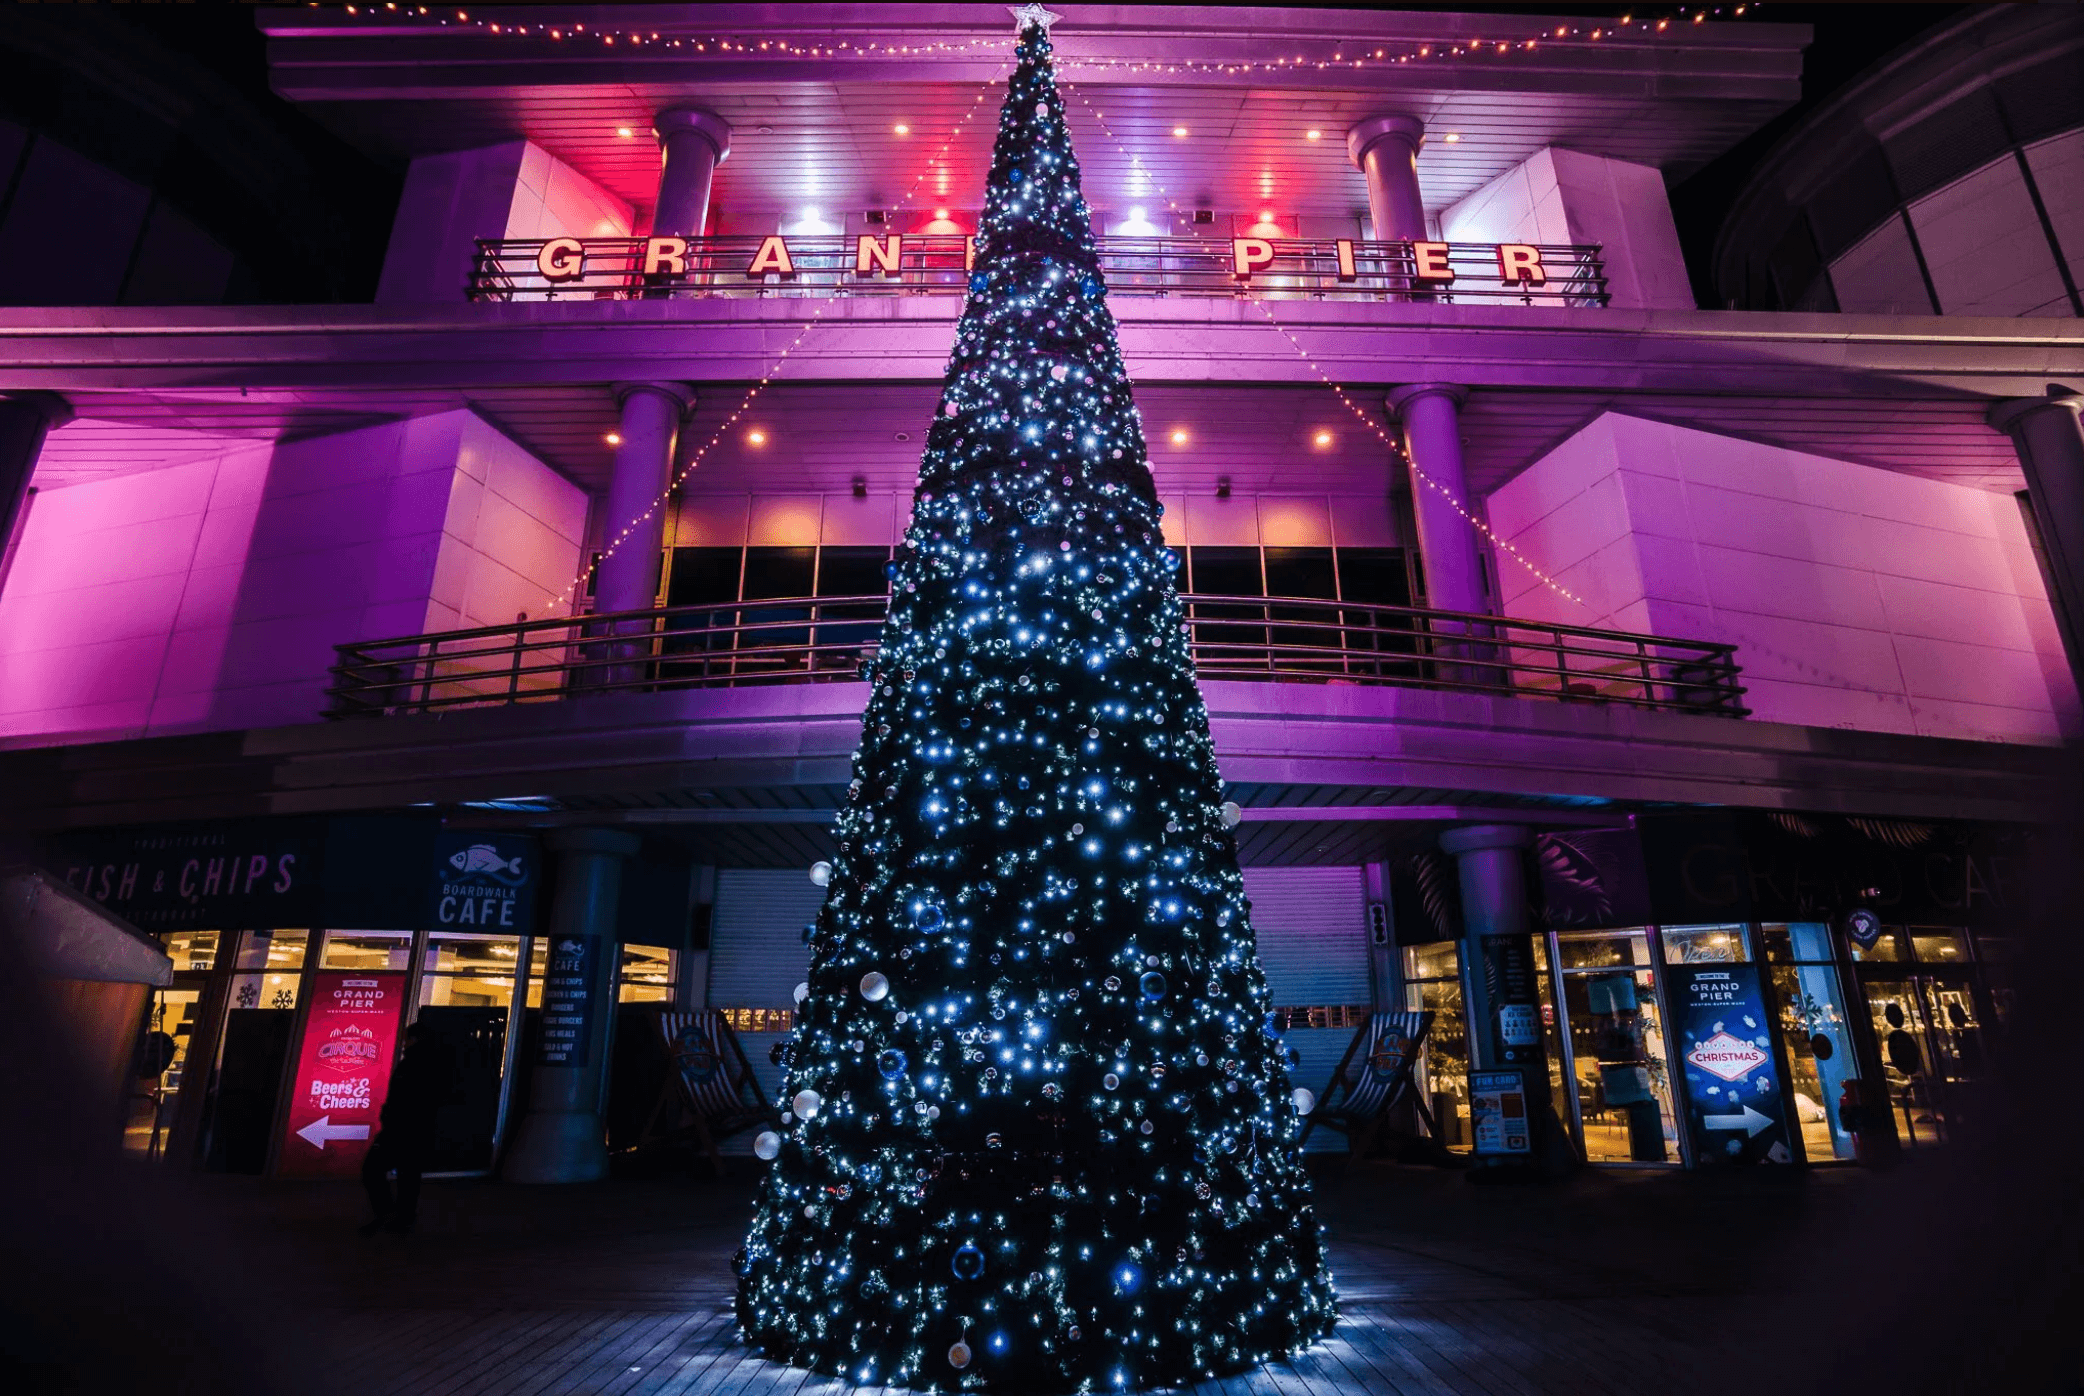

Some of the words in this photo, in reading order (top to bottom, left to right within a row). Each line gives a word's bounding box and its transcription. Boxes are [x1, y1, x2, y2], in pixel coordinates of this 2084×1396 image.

[537, 235, 973, 283] GRAN
[1231, 236, 1547, 288] PIER
[66, 862, 141, 901] FISH
[152, 869, 166, 893] &
[178, 853, 297, 898] CHIPS
[442, 883, 517, 900] BOARDWALK
[438, 896, 517, 926] CAFE
[553, 960, 581, 972] CAFE
[1690, 982, 1740, 991] GRAND
[333, 990, 384, 999] GRAND
[1700, 992, 1733, 1000] PIER
[340, 1000, 374, 1008] PIER
[318, 1041, 378, 1059] CIRQUE
[1695, 1052, 1759, 1062] CHRISTMAS
[311, 1080, 354, 1096] Beers
[352, 1078, 371, 1098] &
[319, 1094, 371, 1109] Cheers
